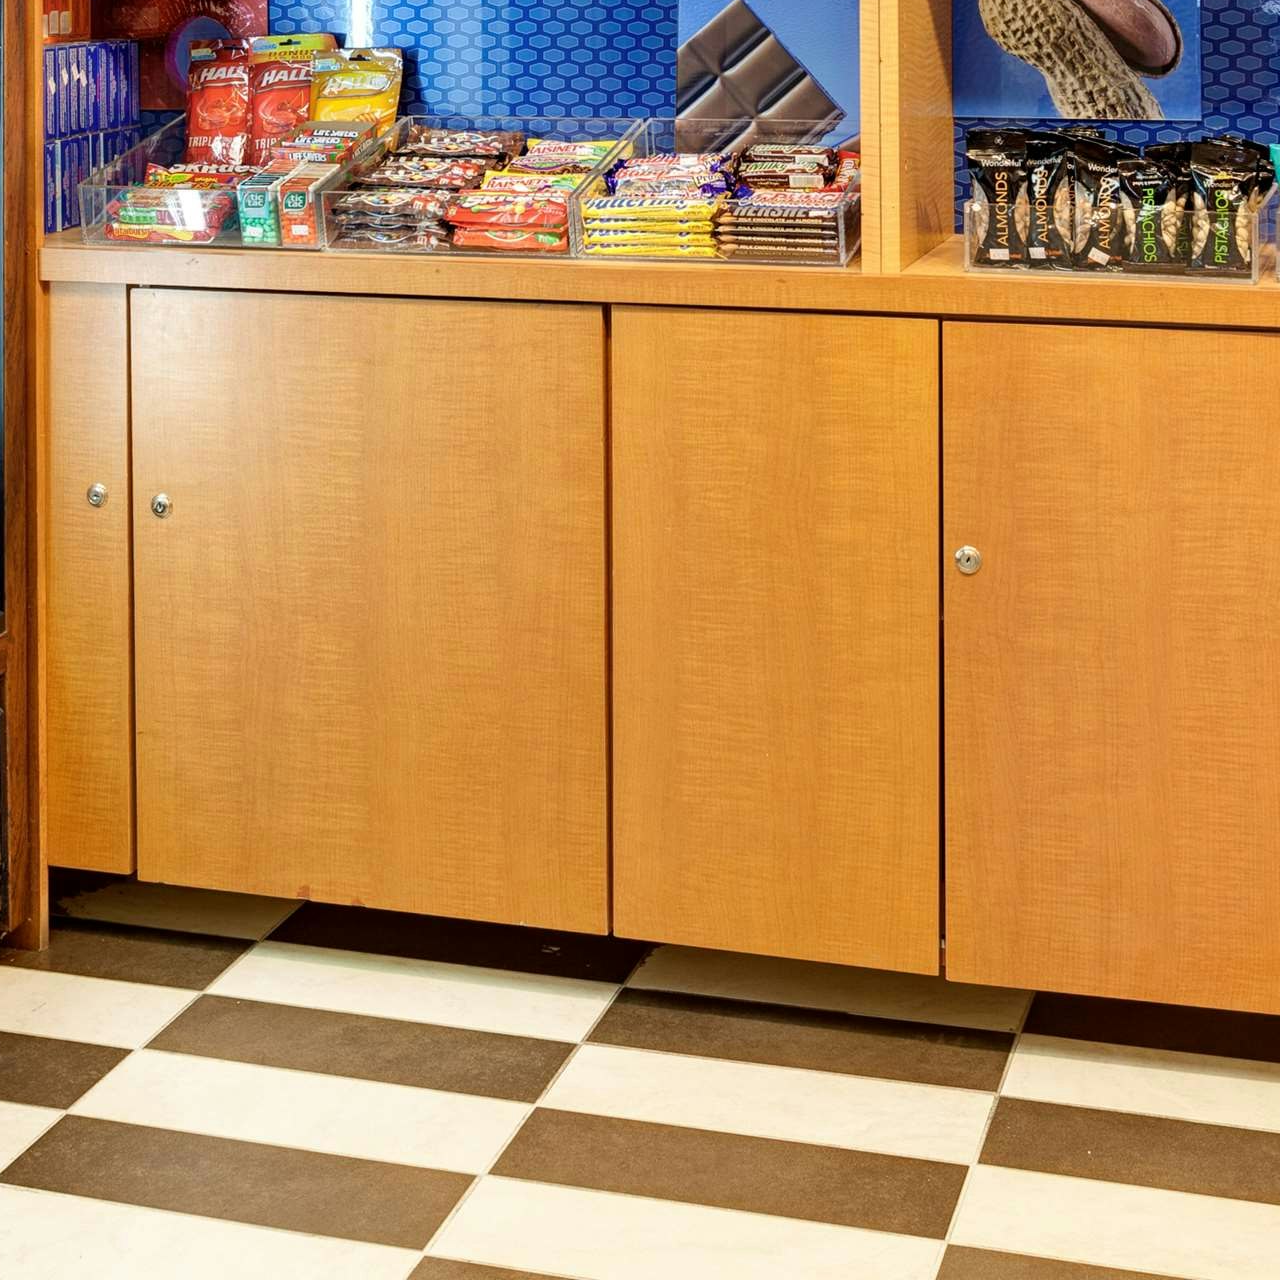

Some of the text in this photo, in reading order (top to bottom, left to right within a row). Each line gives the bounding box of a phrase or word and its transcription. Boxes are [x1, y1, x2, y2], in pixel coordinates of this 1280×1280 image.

[249, 192, 265, 201] tic
[290, 192, 305, 201] tic
[248, 200, 265, 208] tac
[288, 200, 305, 208] tac
[1035, 169, 1049, 244] ALMONDS
[995, 171, 1009, 248] ALMONDS
[1214, 189, 1230, 264] PISTACHIOS
